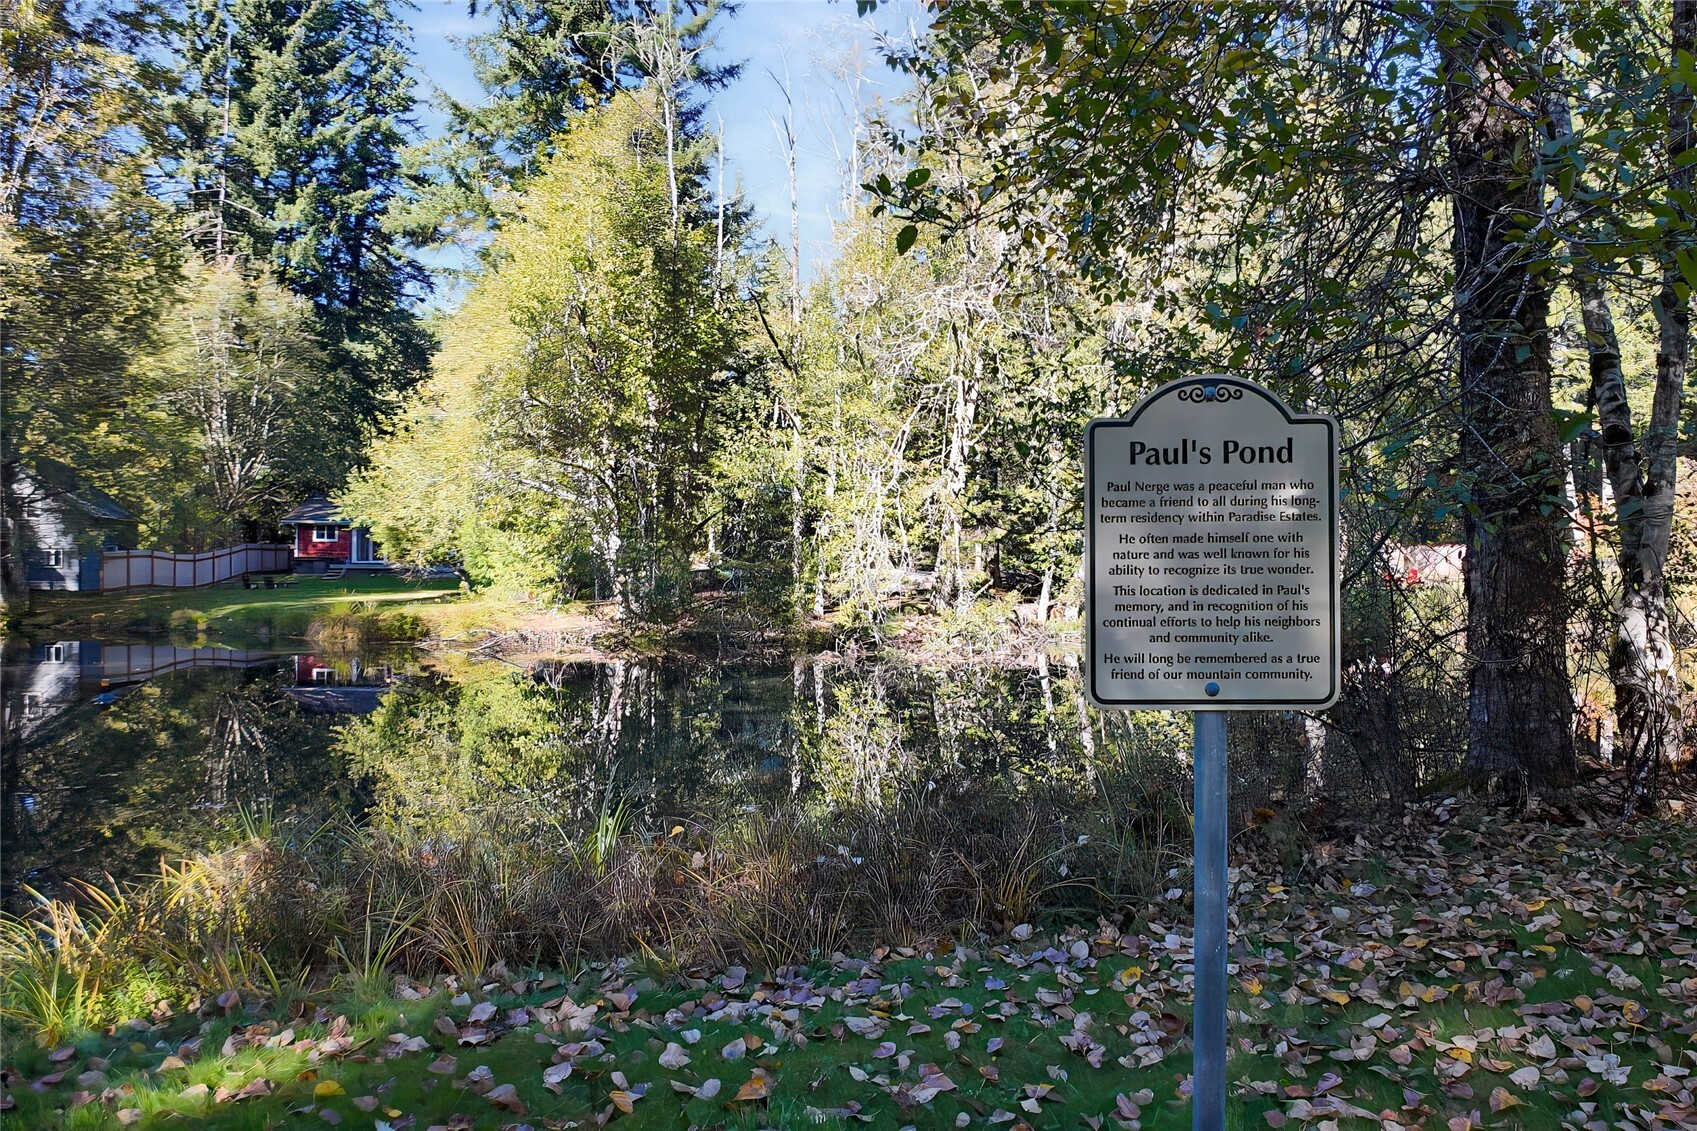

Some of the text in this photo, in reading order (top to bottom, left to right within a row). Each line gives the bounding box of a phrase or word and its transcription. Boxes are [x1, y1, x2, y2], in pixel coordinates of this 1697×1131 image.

[1130, 437, 1293, 465] Paul's Pond
[1107, 479, 1315, 495] Paul Nerge was a peaceful man who
[1101, 494, 1321, 510] became a friend to all during his long-
[1100, 510, 1322, 526] term residency within Paradise Estates.
[1118, 531, 1304, 545] He often made himself one with
[1112, 546, 1310, 561] nature and was well known for his
[1108, 562, 1315, 579] ability to recognize its true wonder.
[1112, 583, 1311, 597] This location is dedicated in Paul's
[1114, 599, 1309, 615] memory, and in recognition of his
[1102, 614, 1322, 631] continual efforts to help his neighbors
[1148, 630, 1274, 646] and community alike.
[1103, 651, 1321, 668] He will long be remembered as a true
[1110, 667, 1313, 683] friend of our mountain community.
